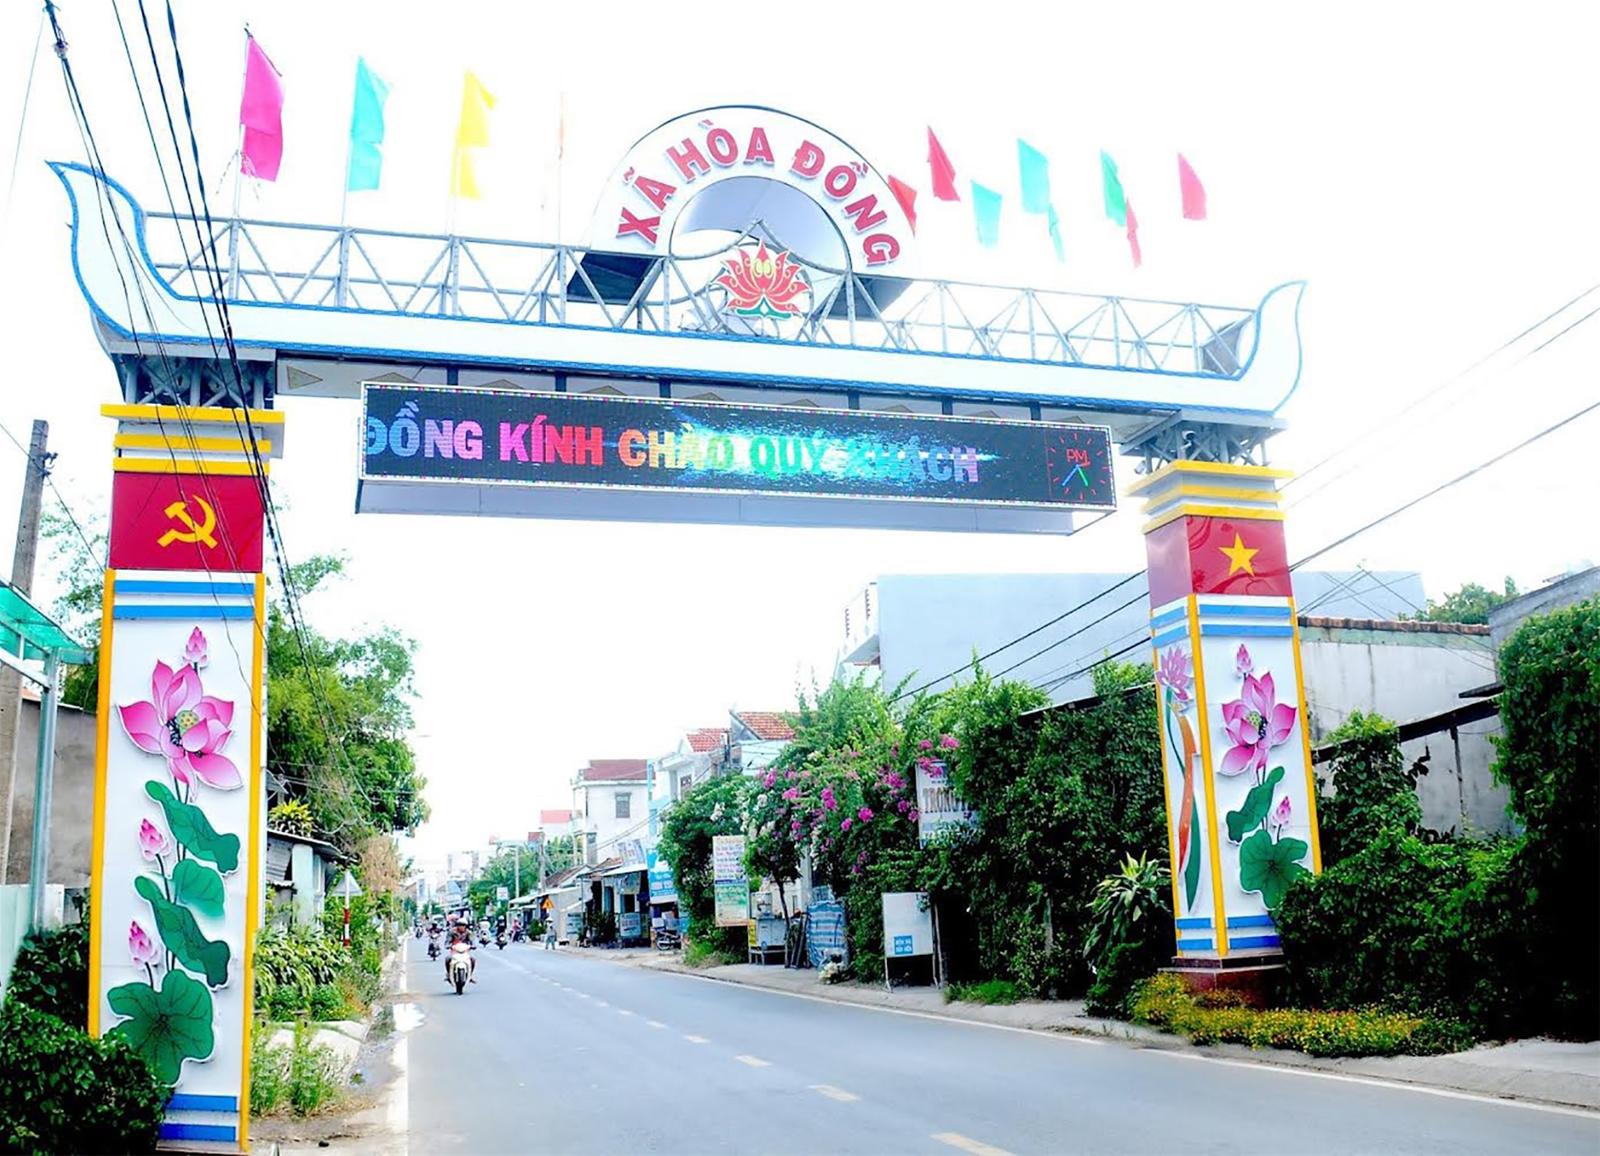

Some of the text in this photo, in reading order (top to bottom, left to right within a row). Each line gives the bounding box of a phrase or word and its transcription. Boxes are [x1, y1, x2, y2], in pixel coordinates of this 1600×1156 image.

[615, 118, 901, 267] XÃ HÒA ĐỒNG
[366, 399, 484, 460] ĐỒNG
[499, 413, 604, 467] KÍNH
[617, 421, 734, 473] CHÀO
[1066, 448, 1088, 463] PM
